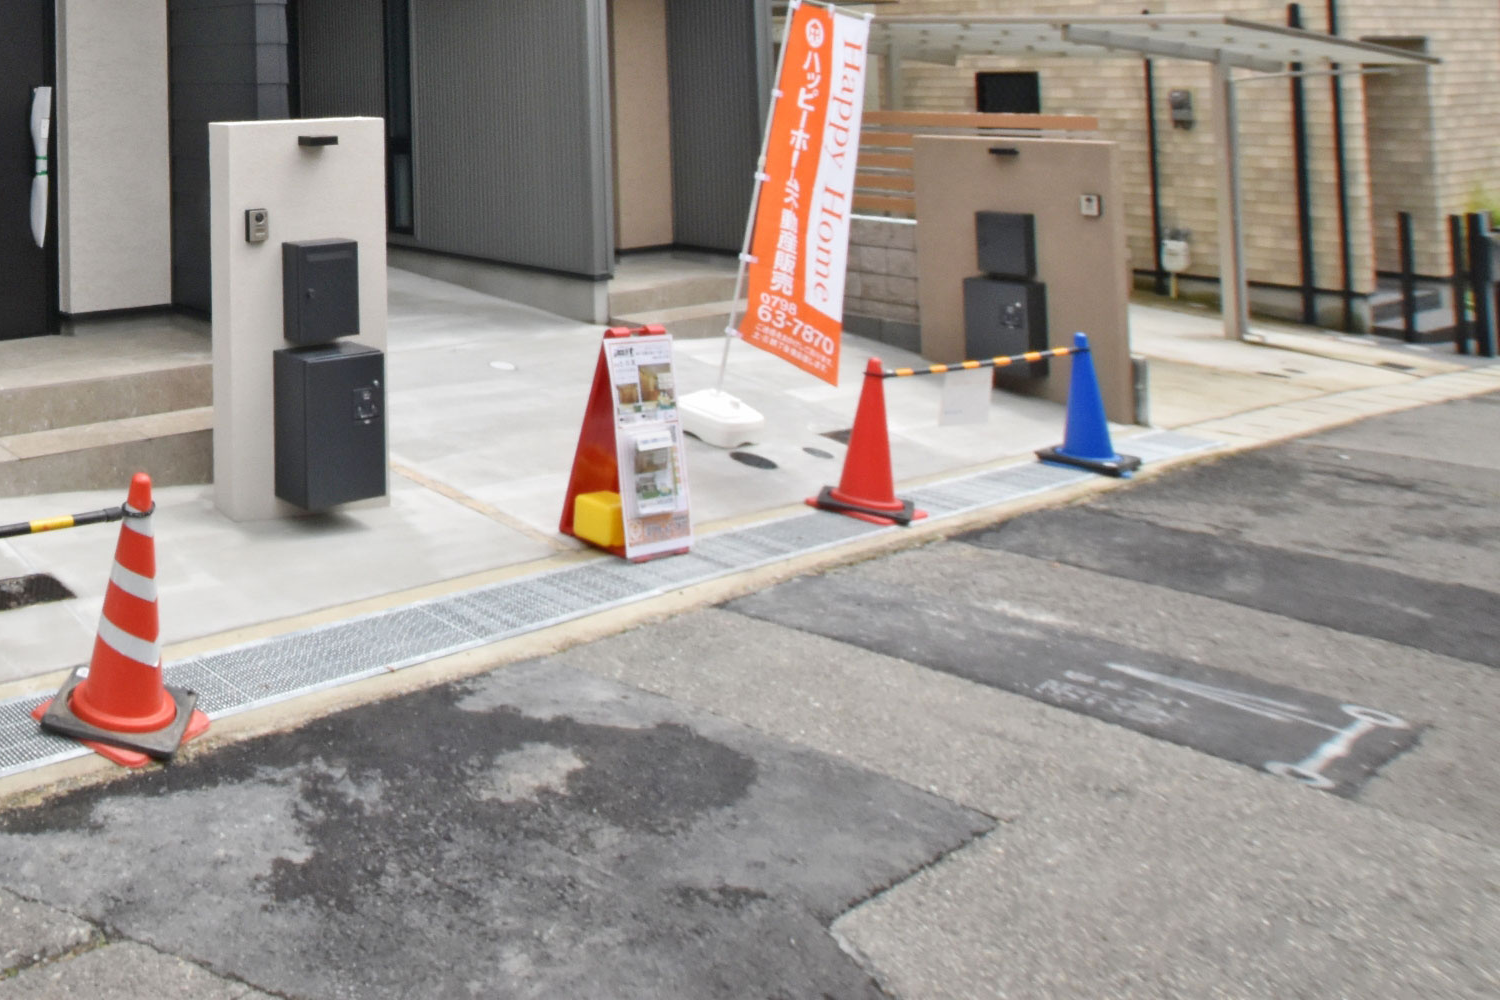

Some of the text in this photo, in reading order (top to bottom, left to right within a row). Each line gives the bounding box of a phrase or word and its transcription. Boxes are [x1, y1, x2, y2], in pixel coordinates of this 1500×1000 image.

[813, 39, 863, 303] Happy Home
[757, 304, 835, 356] 63-7870
[760, 292, 798, 316] 0798
